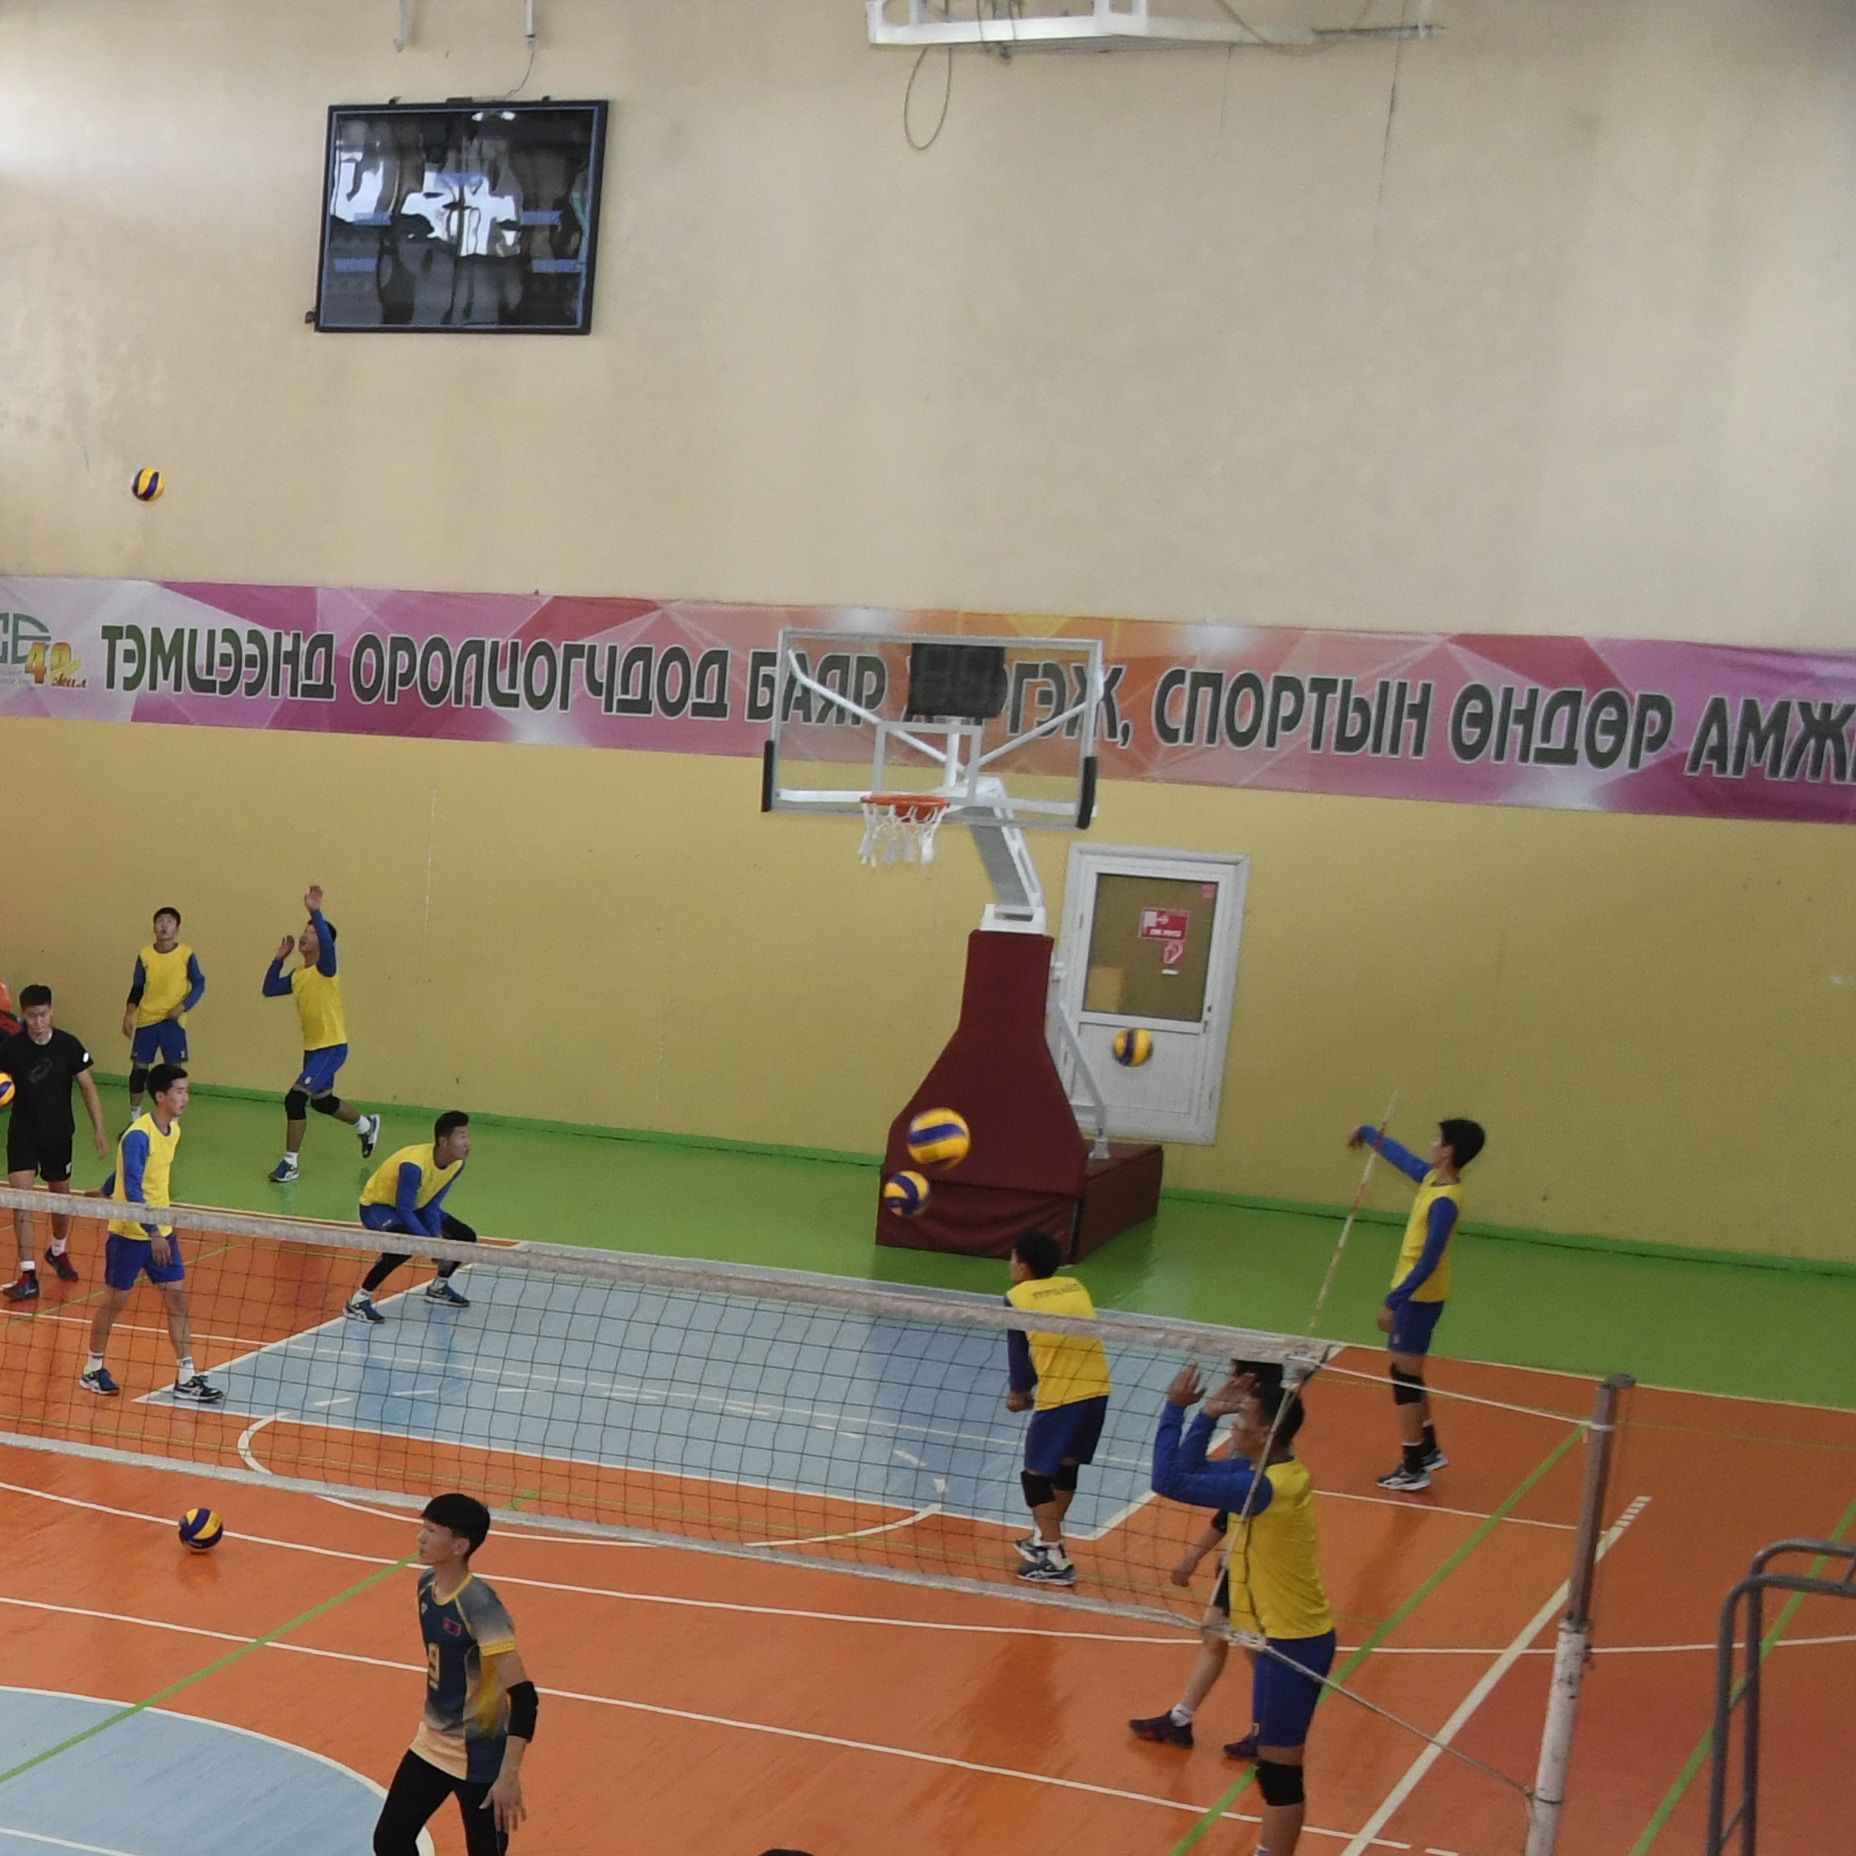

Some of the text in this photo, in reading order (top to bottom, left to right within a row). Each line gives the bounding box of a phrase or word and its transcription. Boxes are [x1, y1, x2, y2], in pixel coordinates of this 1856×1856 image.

[100, 623, 336, 701] ТЭМЦЭЭНД
[350, 632, 730, 719] ОРОЛЦОГЧДОД
[745, 648, 888, 727] БАЯР
[1152, 667, 1437, 760] СПОРТЫН
[1448, 682, 1676, 770] ӨНДӨР
[1684, 695, 1856, 785] АМЖ
